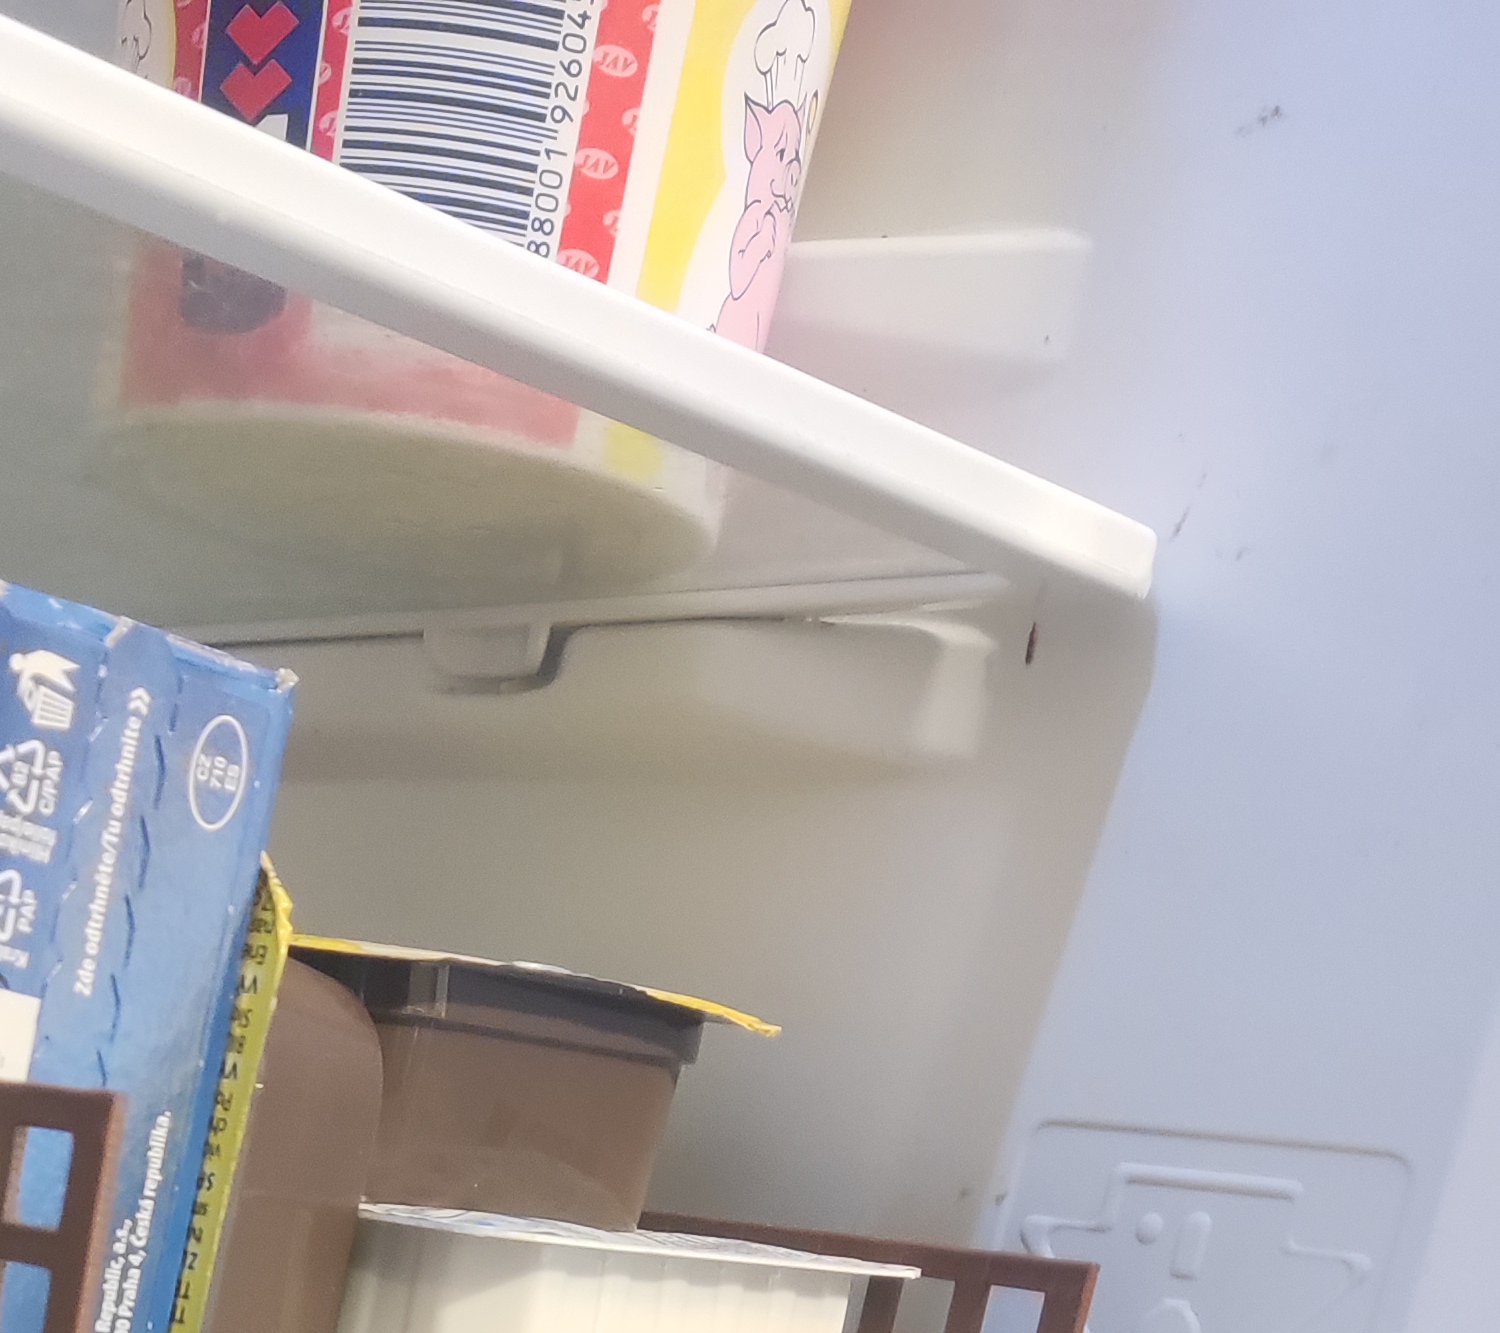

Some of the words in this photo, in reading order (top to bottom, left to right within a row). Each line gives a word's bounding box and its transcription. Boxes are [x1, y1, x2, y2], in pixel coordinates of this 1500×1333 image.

[196, 752, 212, 781] CZ
[16, 889, 37, 934] PAP
[73, 957, 97, 997] Zde
